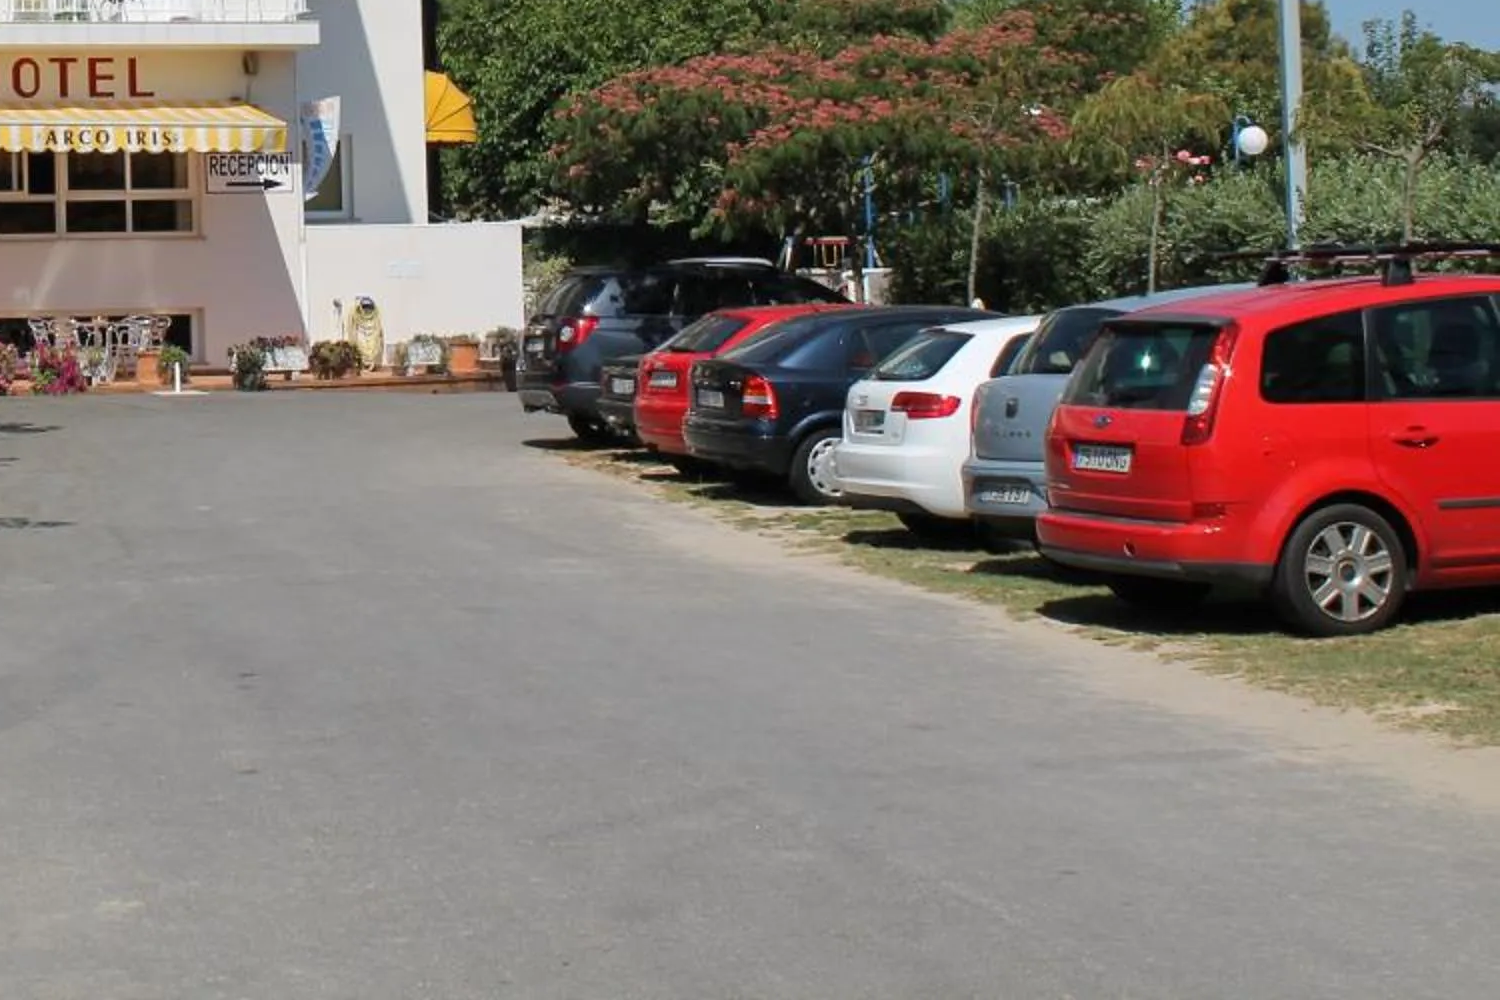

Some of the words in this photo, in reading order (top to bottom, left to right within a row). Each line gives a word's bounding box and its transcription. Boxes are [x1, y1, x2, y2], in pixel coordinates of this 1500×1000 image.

[44, 128, 110, 146] ARCO
[125, 129, 172, 147] IRIS
[208, 153, 290, 177] RECEPCION
